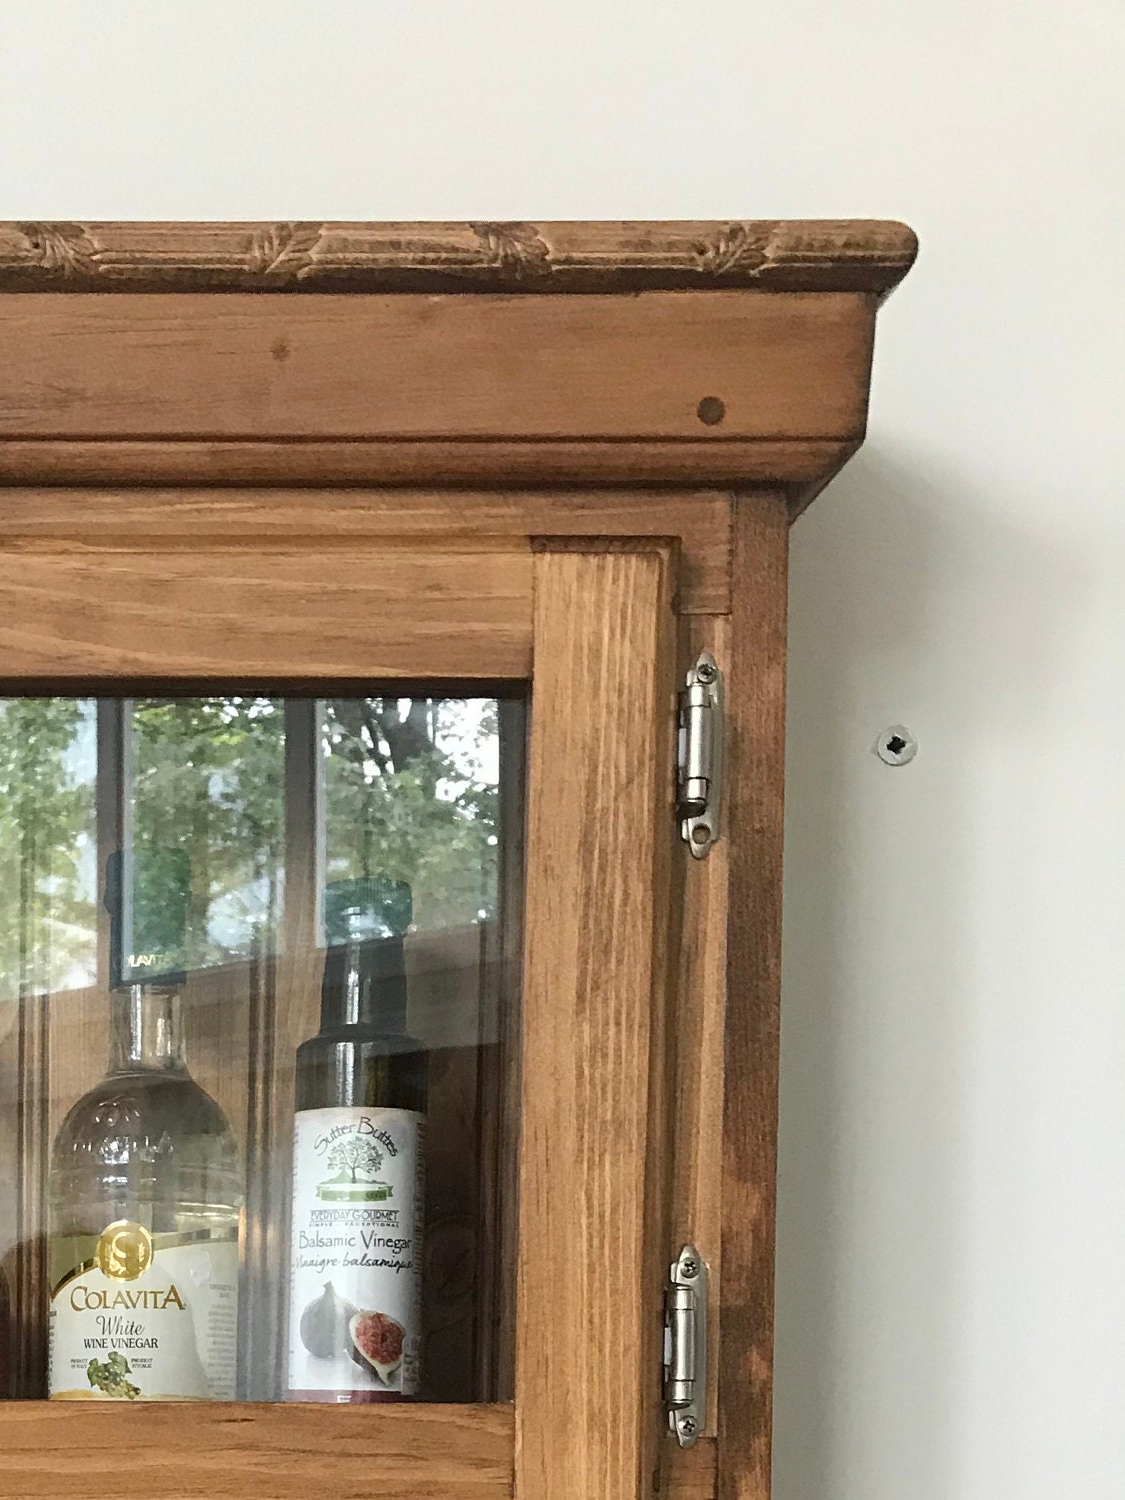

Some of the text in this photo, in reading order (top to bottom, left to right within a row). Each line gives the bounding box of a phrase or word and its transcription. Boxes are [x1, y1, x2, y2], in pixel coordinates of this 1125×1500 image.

[314, 1116, 399, 1157] Sutter Buttes
[311, 1210, 398, 1221] EVERYDAY GOURMET
[299, 1230, 412, 1254] Balsamic Vinegar
[342, 1252, 414, 1274] balsamique
[70, 1284, 187, 1312] COLAVITA
[95, 1315, 146, 1336] White
[83, 1338, 159, 1349] WINE VINEGAR
